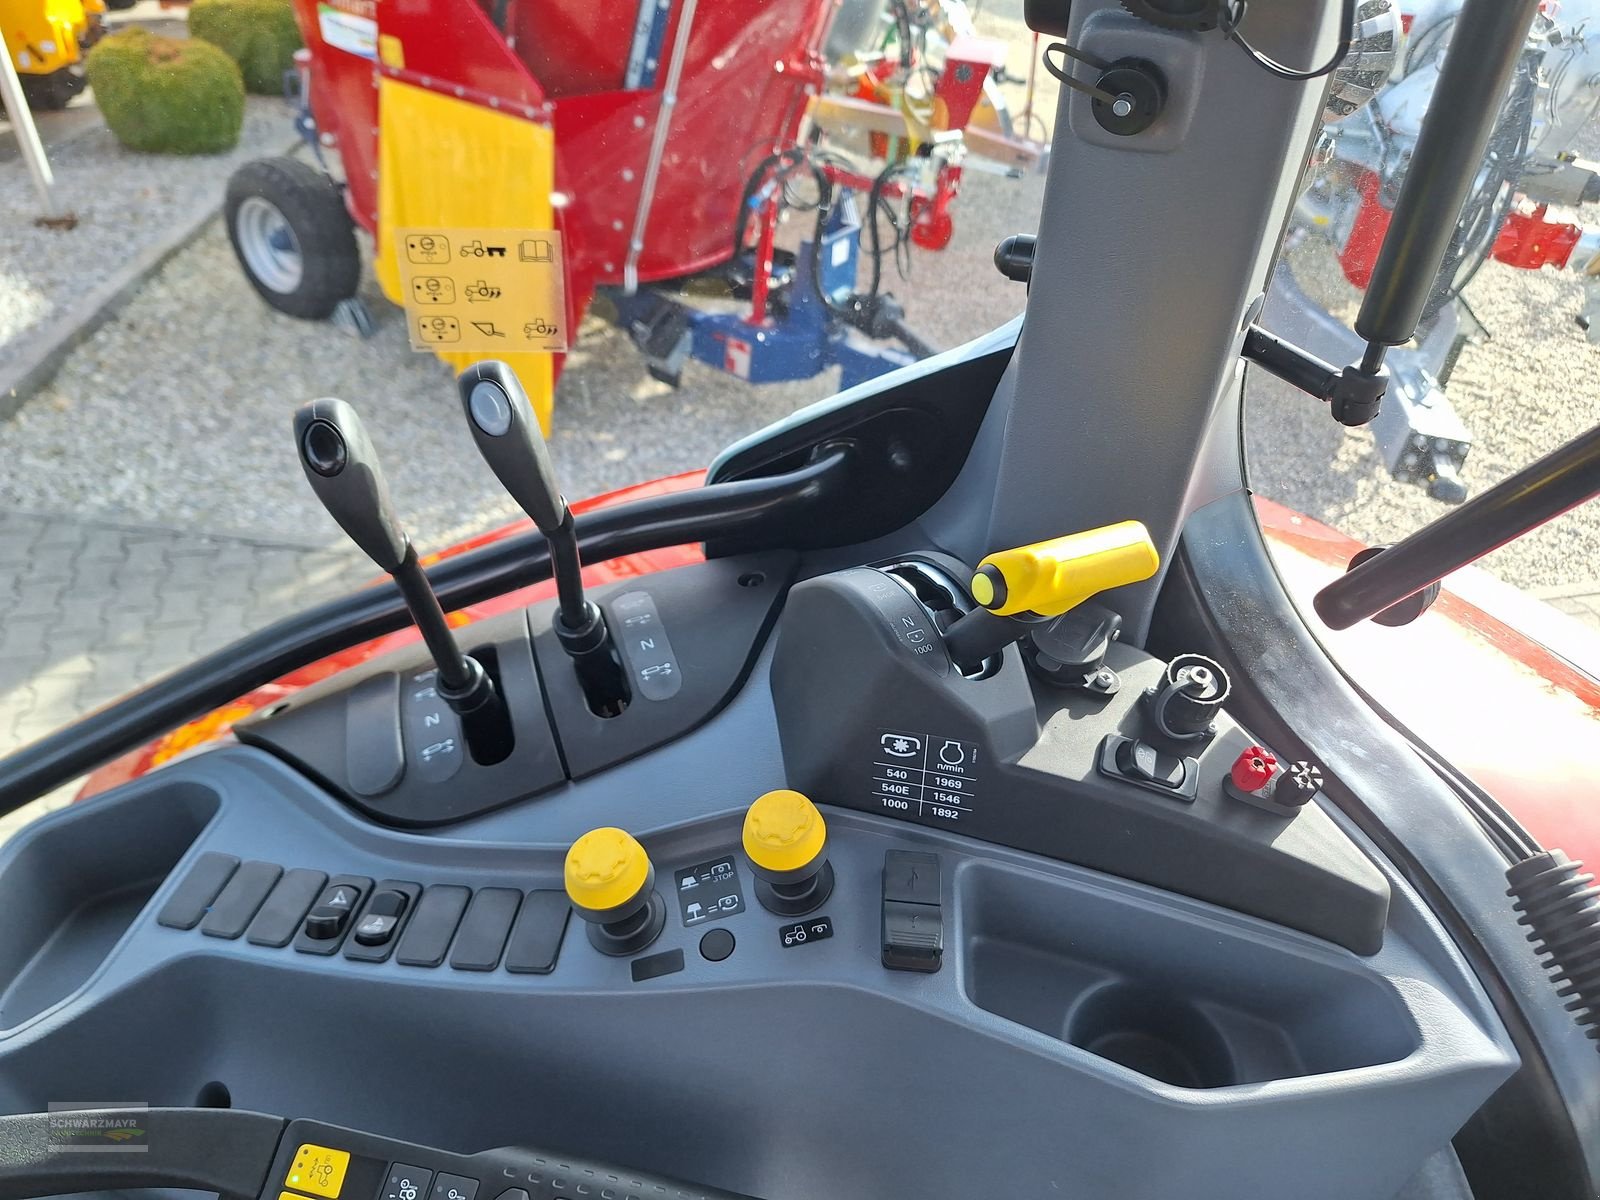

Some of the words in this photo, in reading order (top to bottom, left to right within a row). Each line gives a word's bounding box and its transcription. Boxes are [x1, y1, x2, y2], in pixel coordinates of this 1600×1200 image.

[902, 616, 915, 628] N
[640, 638, 655, 651] N
[914, 644, 933, 655] 1000
[424, 713, 440, 727] N
[886, 768, 908, 780] 540
[936, 763, 964, 774] n/min
[881, 783, 910, 795] 540E
[934, 777, 962, 789] 1969
[881, 798, 908, 810] 1000
[933, 792, 961, 805] 1546
[931, 807, 959, 820] 1892
[712, 871, 735, 883] STOP
